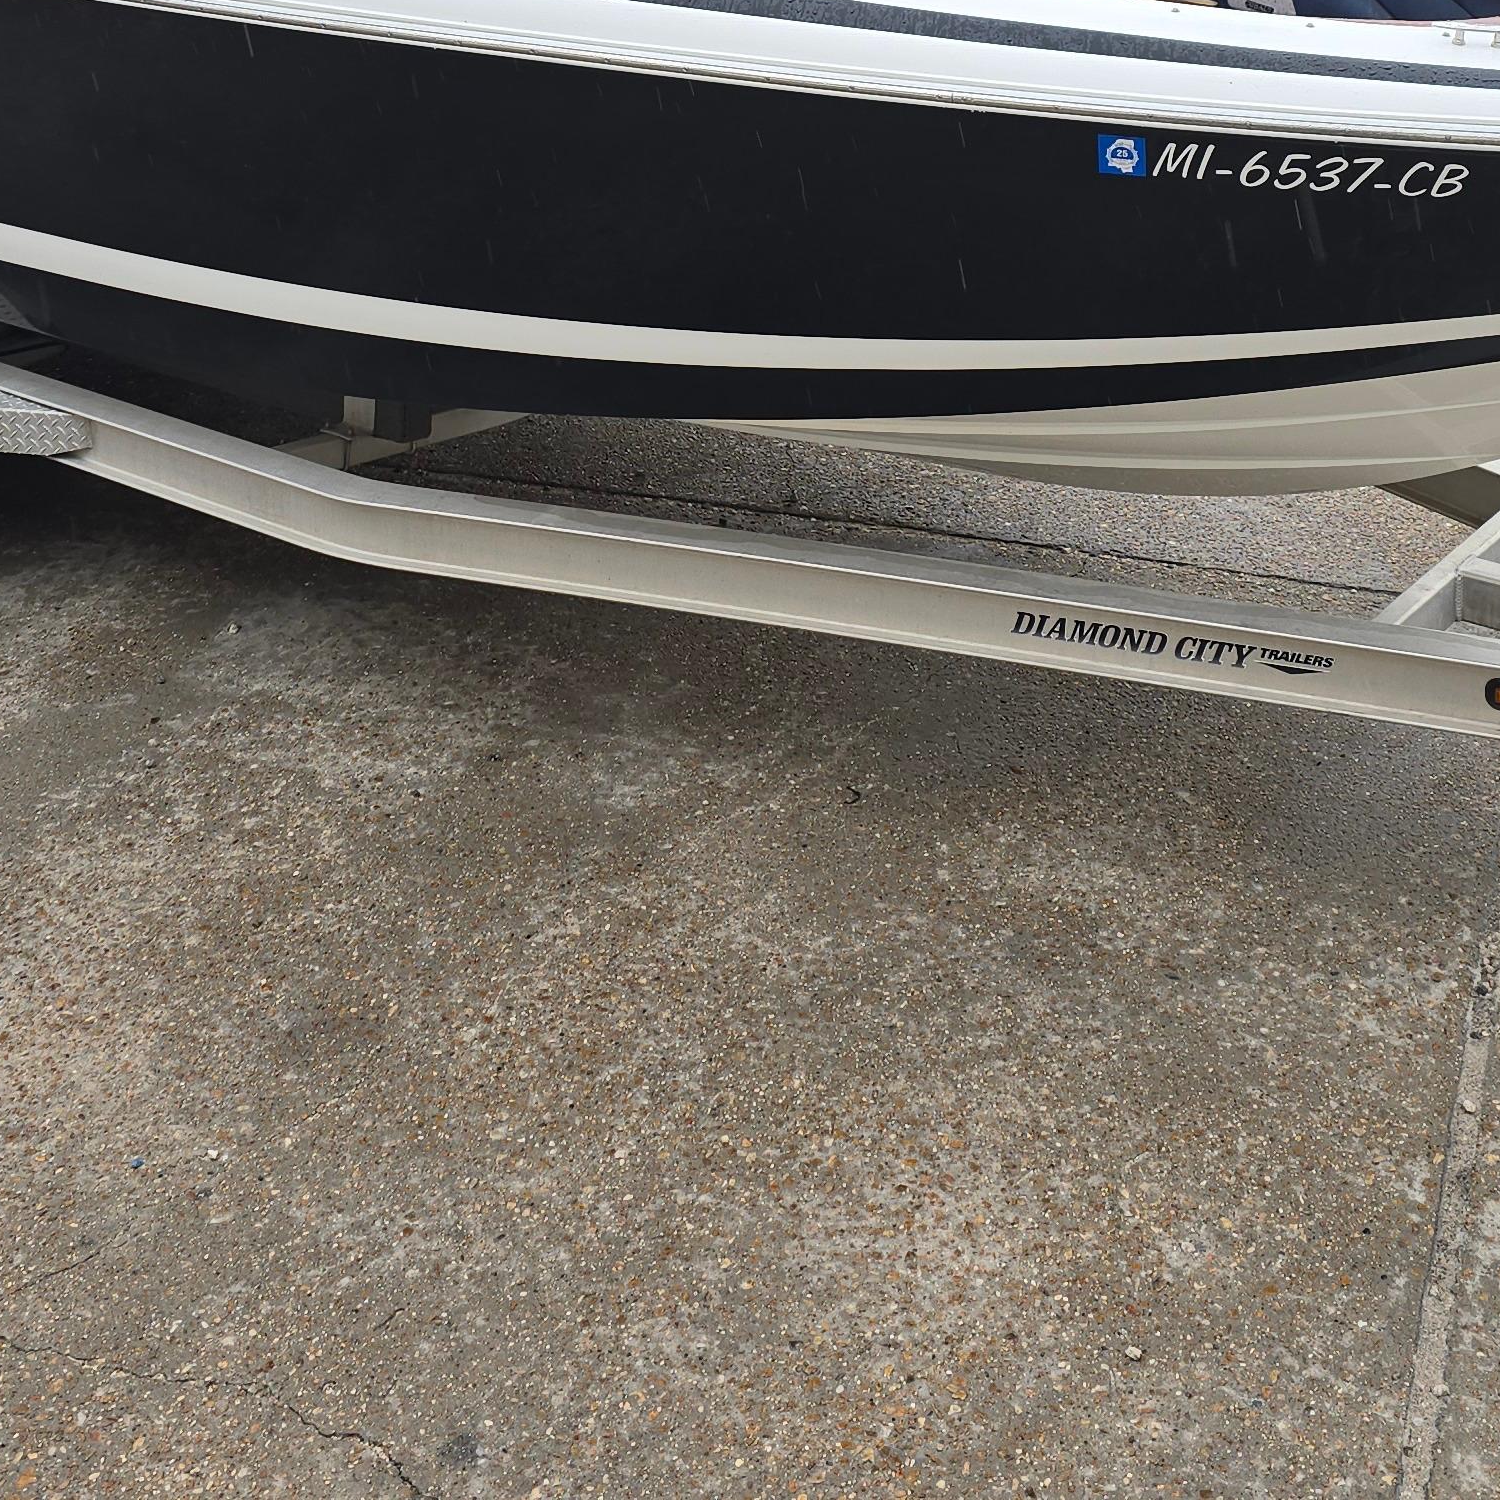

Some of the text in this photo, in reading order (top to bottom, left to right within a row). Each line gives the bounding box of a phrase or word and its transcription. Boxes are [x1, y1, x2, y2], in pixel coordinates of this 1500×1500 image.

[1116, 149, 1129, 158] 25
[1152, 141, 1470, 198] MI-6537-CB
[1010, 611, 1334, 669] DIAMOND CITY TRAILERS
